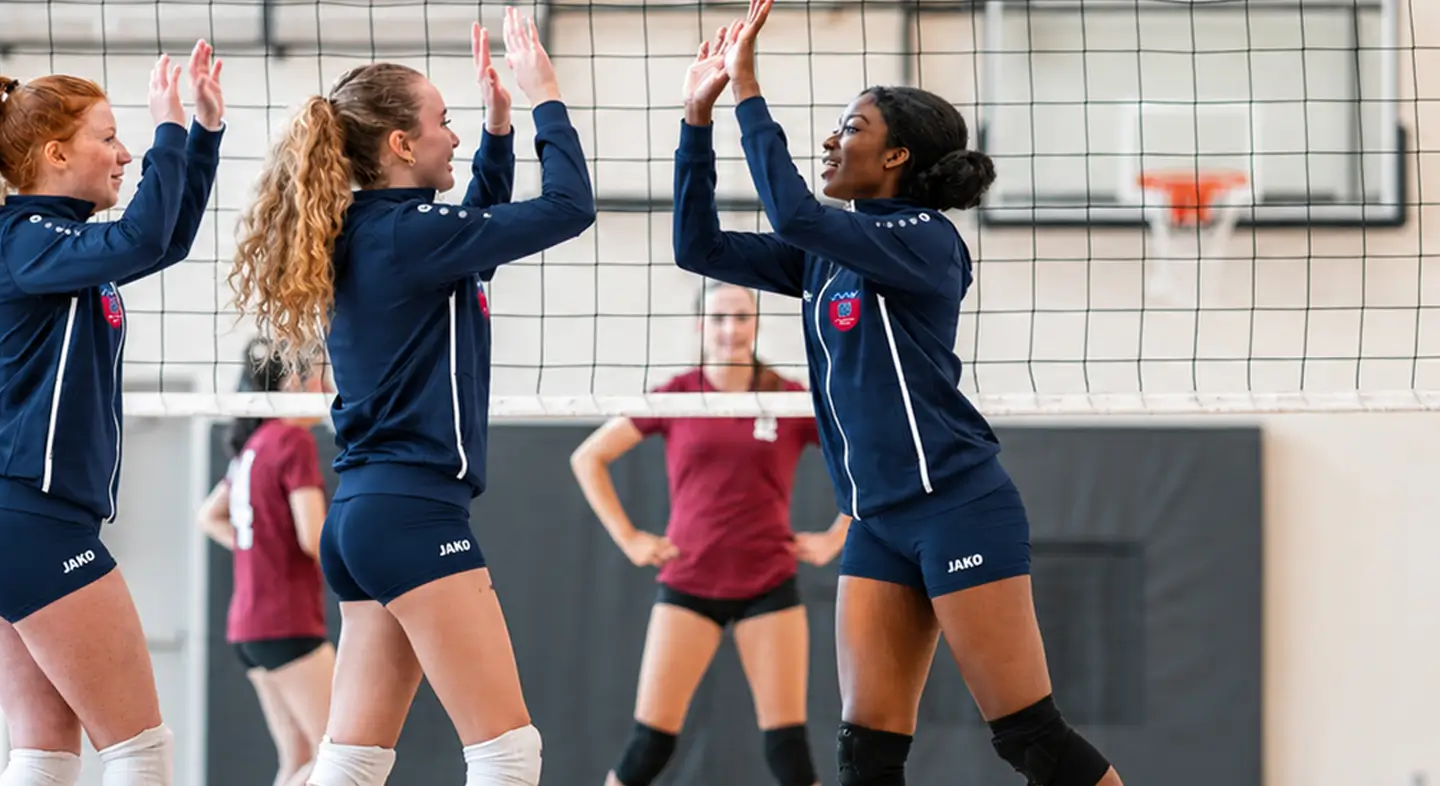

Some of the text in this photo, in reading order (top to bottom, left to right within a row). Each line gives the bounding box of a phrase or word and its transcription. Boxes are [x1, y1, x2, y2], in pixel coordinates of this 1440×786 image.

[440, 539, 471, 556] JAKO
[63, 550, 95, 573] JAKO
[948, 553, 983, 573] JAKO
